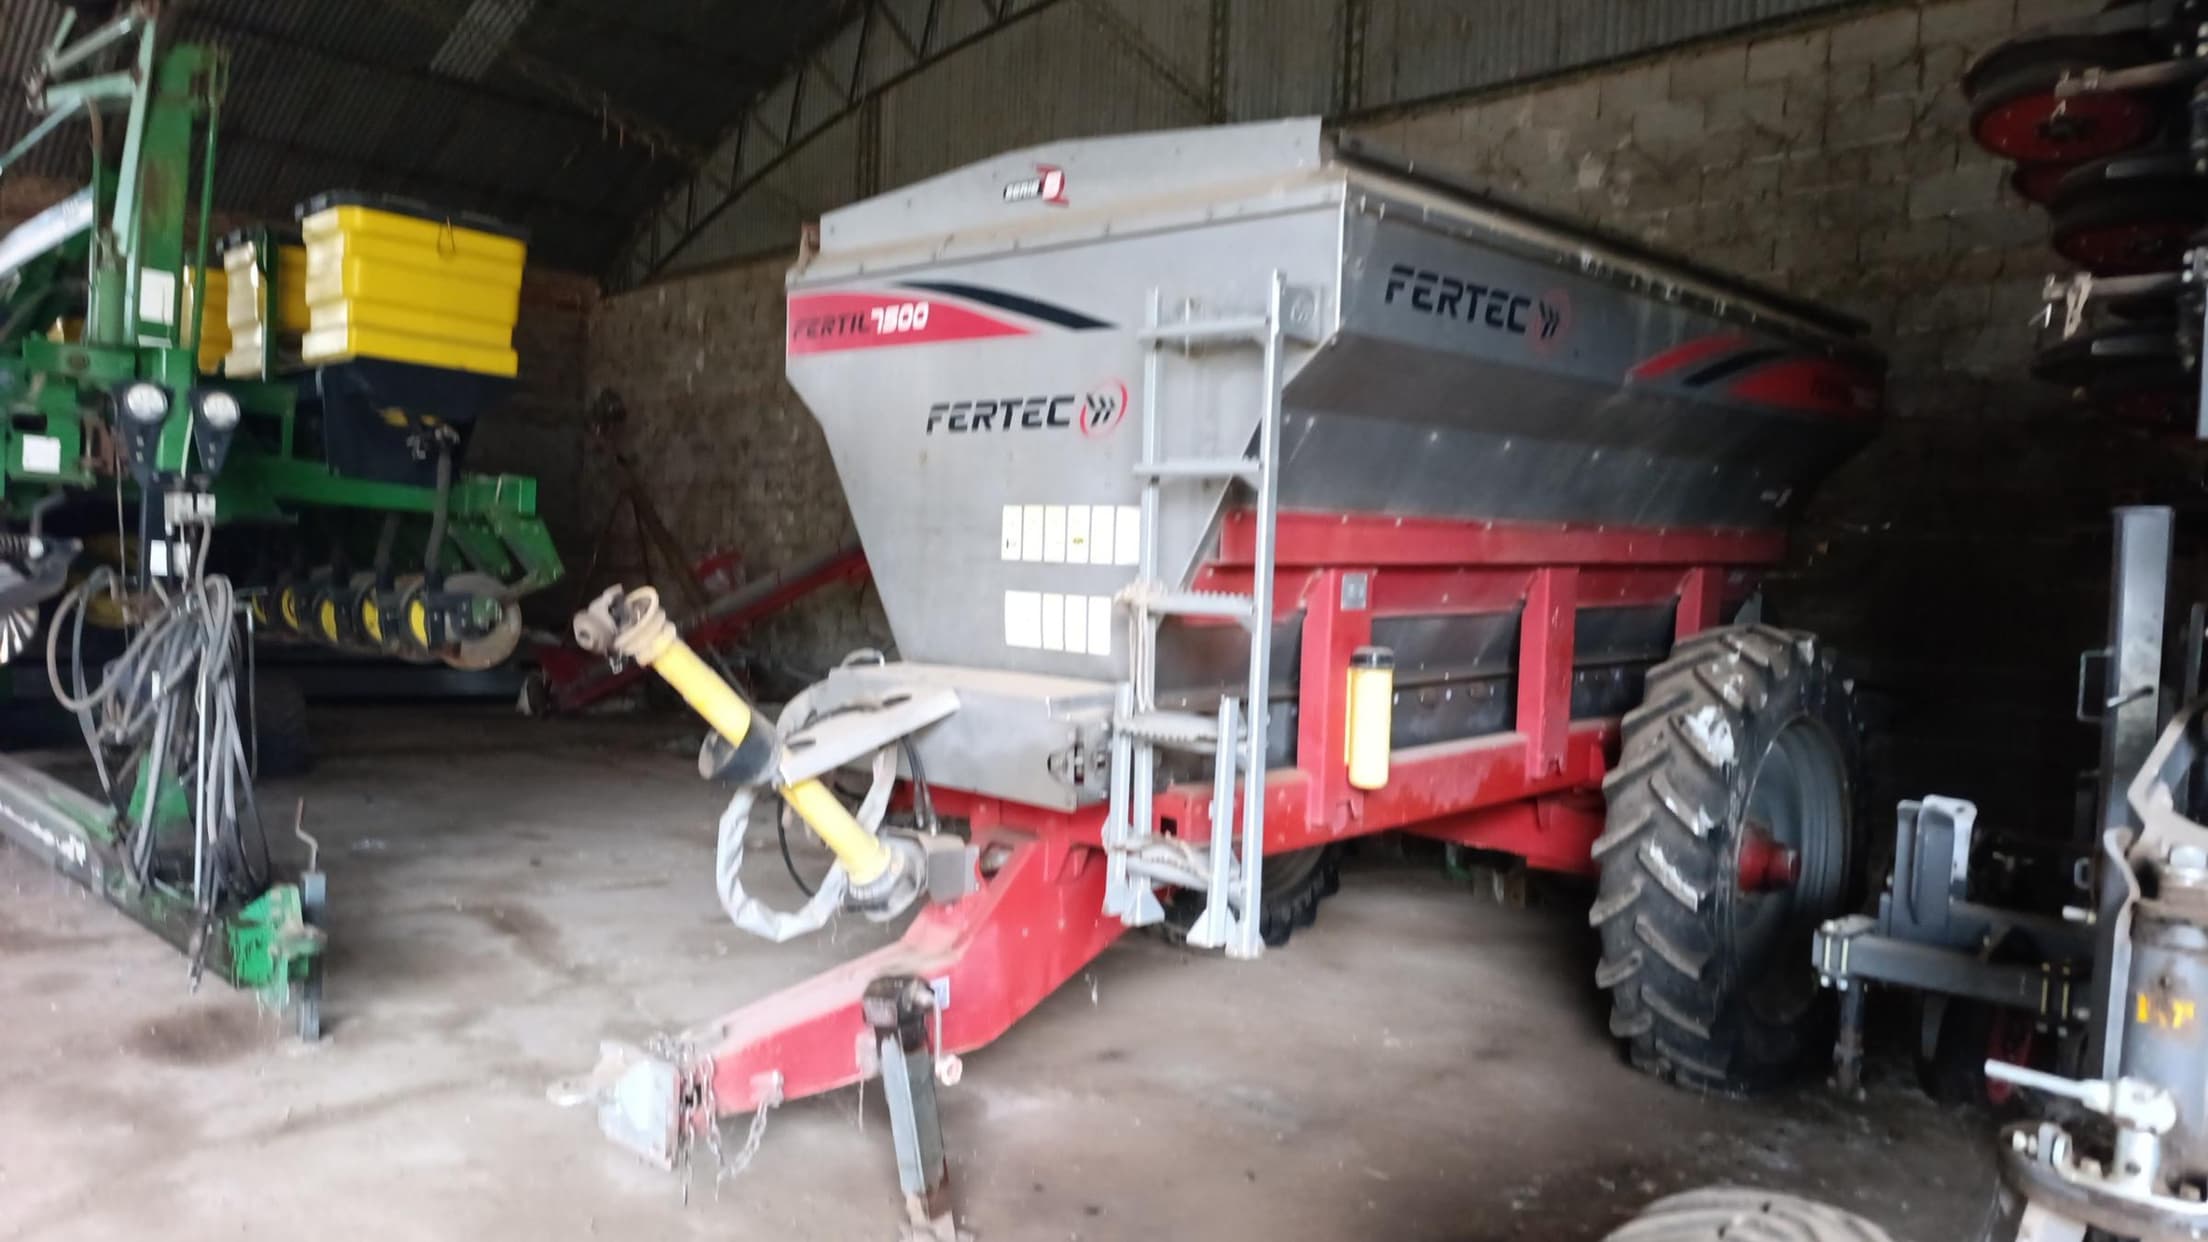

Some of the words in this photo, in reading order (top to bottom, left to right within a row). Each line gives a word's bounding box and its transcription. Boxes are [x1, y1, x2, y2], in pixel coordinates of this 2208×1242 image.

[1384, 263, 1531, 334] FERTEC
[792, 312, 869, 341] FERTIL
[926, 394, 1075, 435] FERTEC
